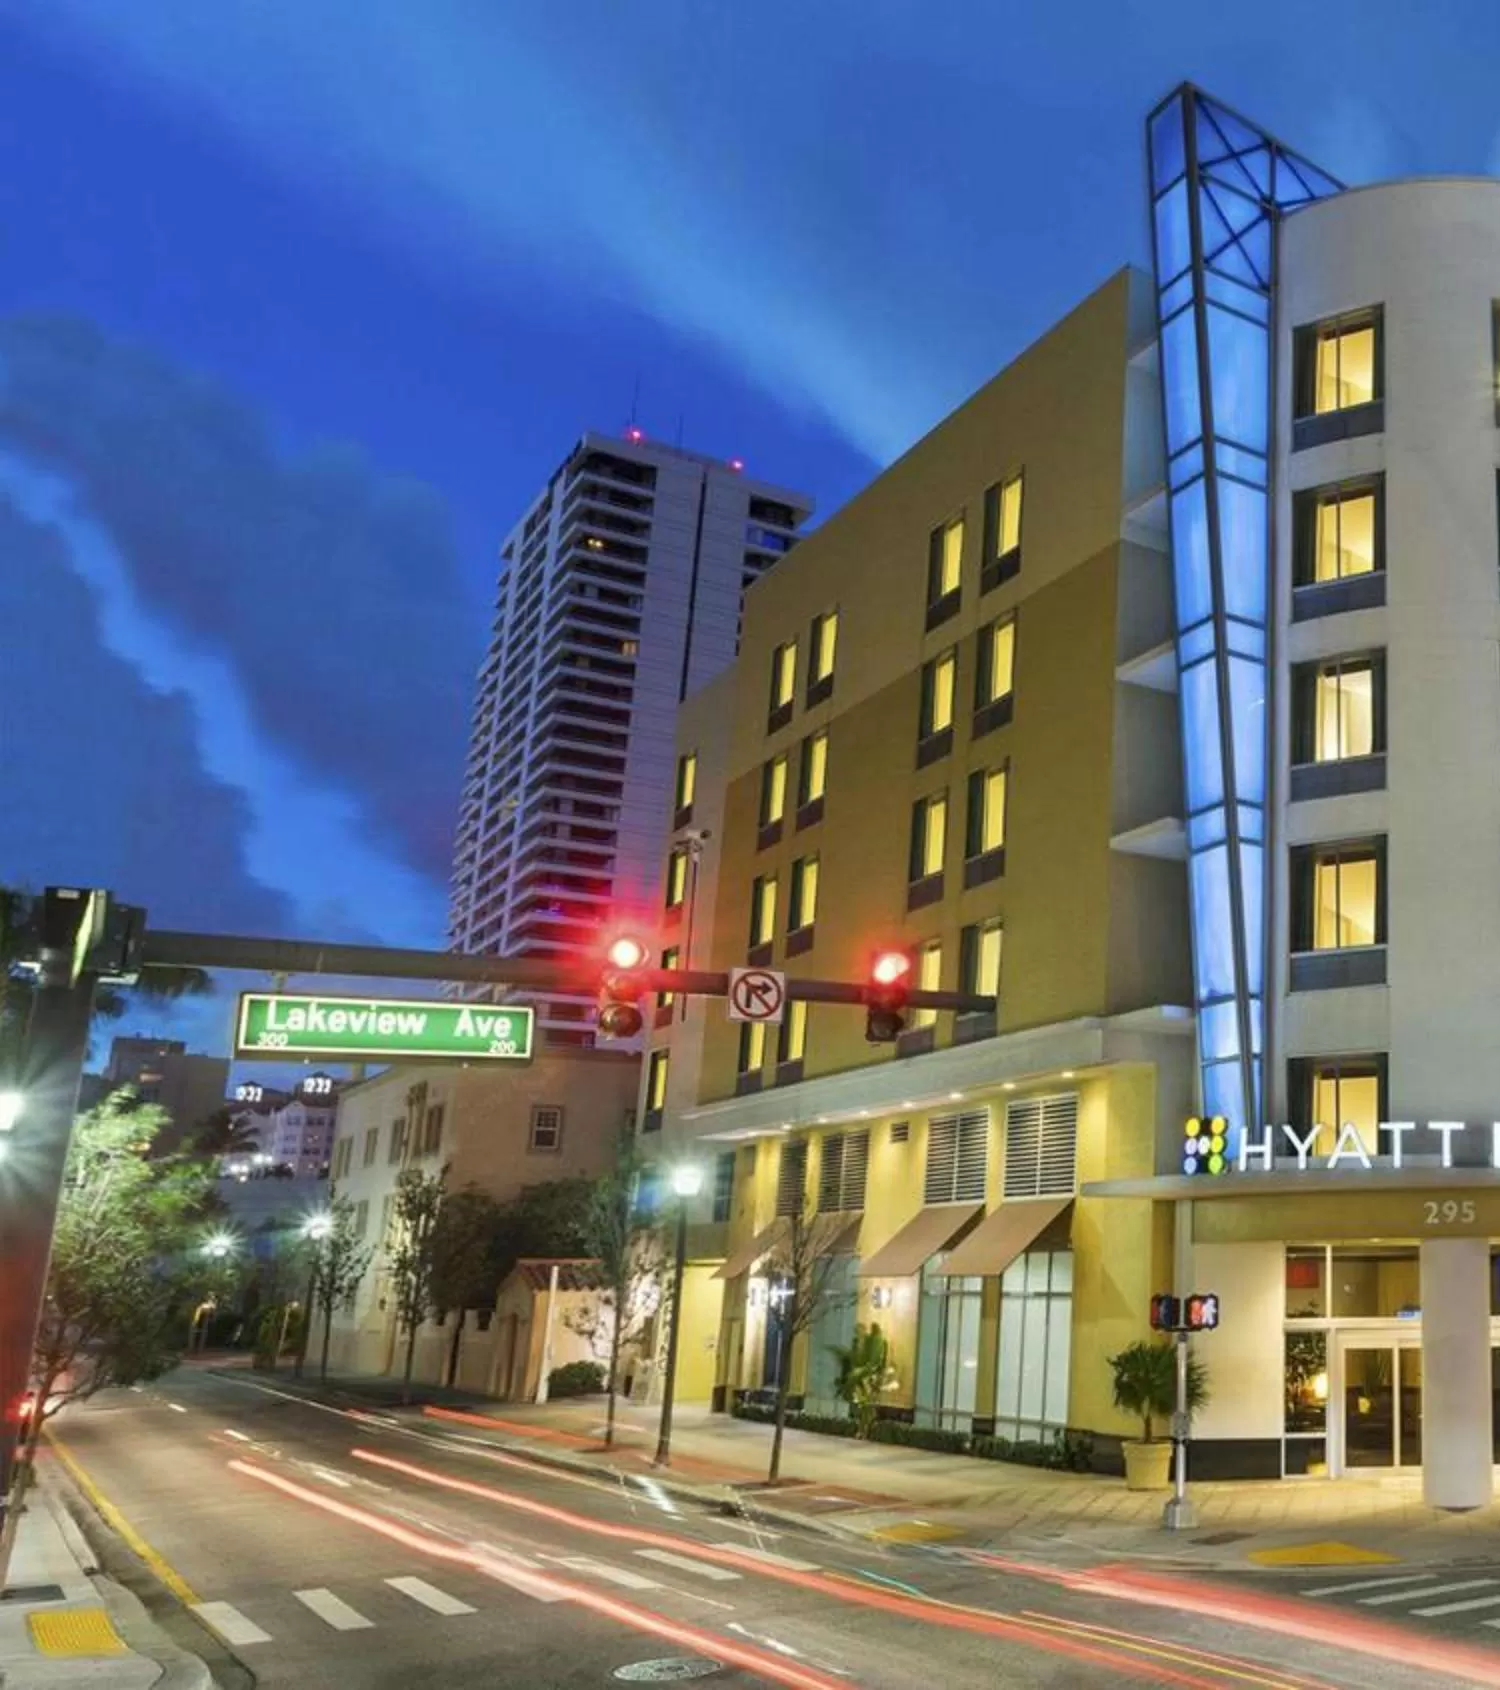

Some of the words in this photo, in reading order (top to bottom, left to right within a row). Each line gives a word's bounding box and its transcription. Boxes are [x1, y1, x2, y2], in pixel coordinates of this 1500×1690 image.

[265, 1000, 427, 1034] Lakeview
[453, 1008, 513, 1039] Ave
[257, 1031, 289, 1048] 300
[489, 1039, 517, 1055] 200
[1238, 1121, 1466, 1172] HYATT
[1423, 1201, 1477, 1225] 295
